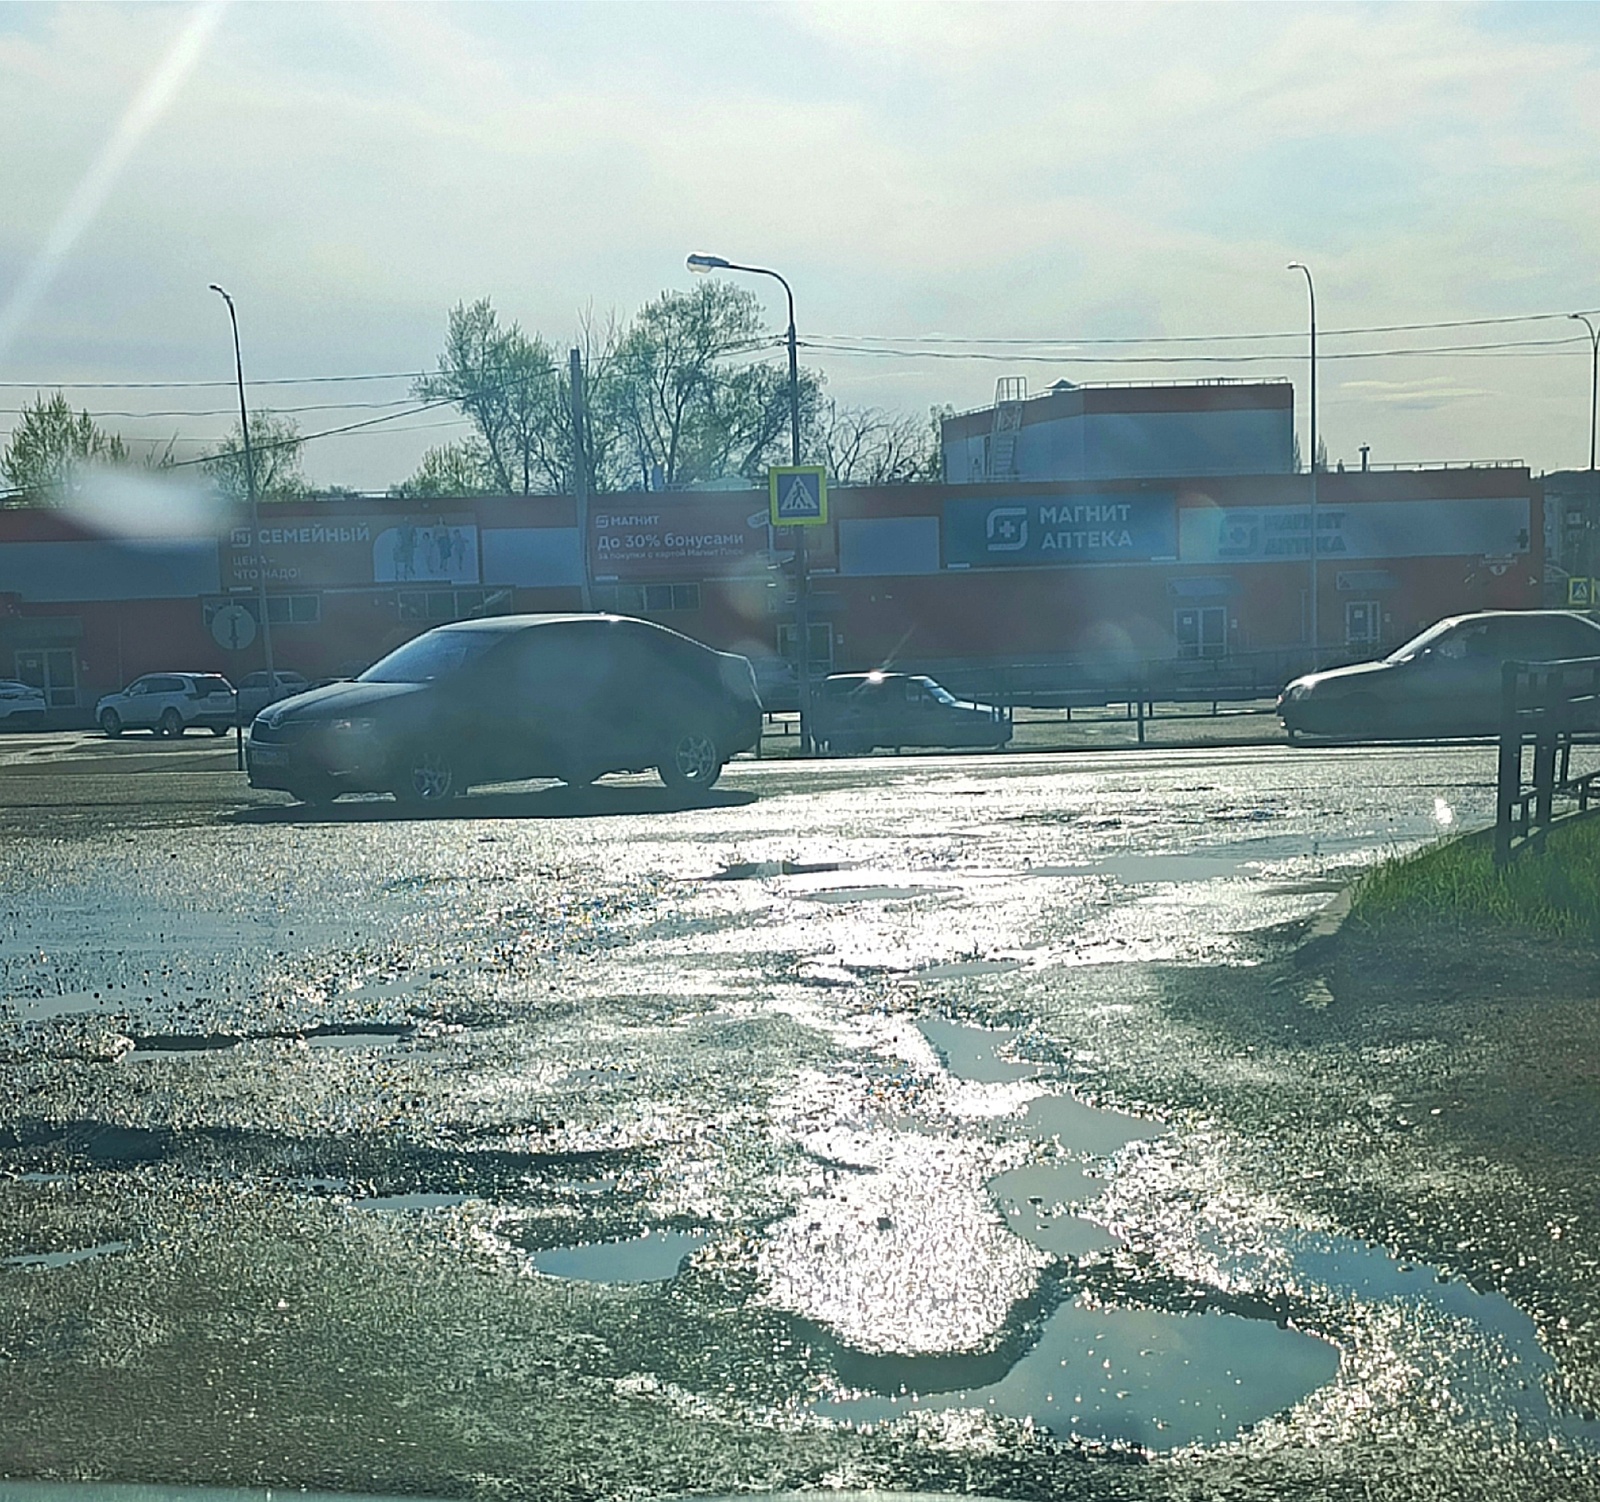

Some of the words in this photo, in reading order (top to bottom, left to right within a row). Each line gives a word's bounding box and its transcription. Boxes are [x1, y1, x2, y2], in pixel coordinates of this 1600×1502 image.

[611, 514, 660, 527] МАГНИТ
[1039, 504, 1132, 524] МАГНИТ
[258, 521, 370, 544] СЕМЕЙНЫЙ
[597, 535, 621, 551] До
[625, 534, 661, 548] 30%
[664, 532, 744, 548] бонусами
[1041, 529, 1133, 550] АПТЕКА
[233, 568, 258, 580] ЧТО
